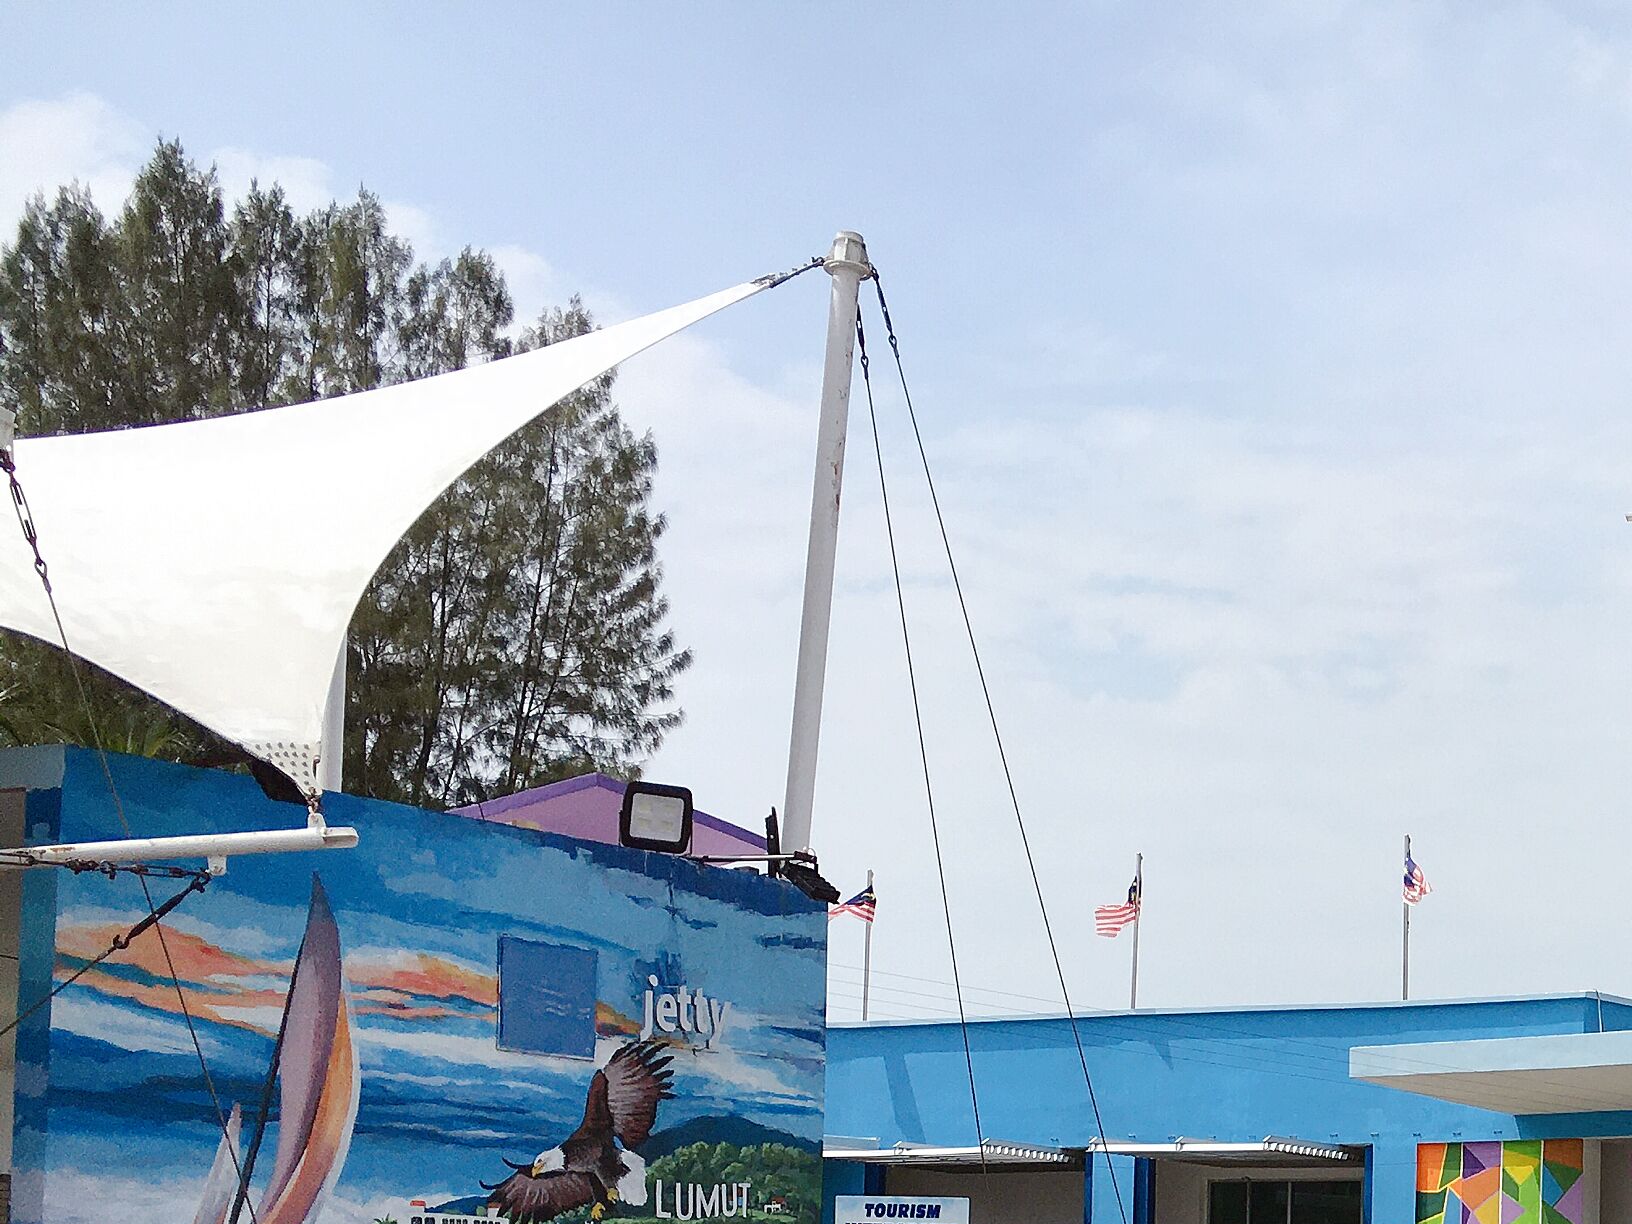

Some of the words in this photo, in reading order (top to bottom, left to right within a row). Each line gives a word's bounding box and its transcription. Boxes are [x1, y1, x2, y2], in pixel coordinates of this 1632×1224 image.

[640, 974, 732, 1050] jetty
[655, 1179, 751, 1221] LUMUT
[864, 1203, 942, 1219] TOURISM
